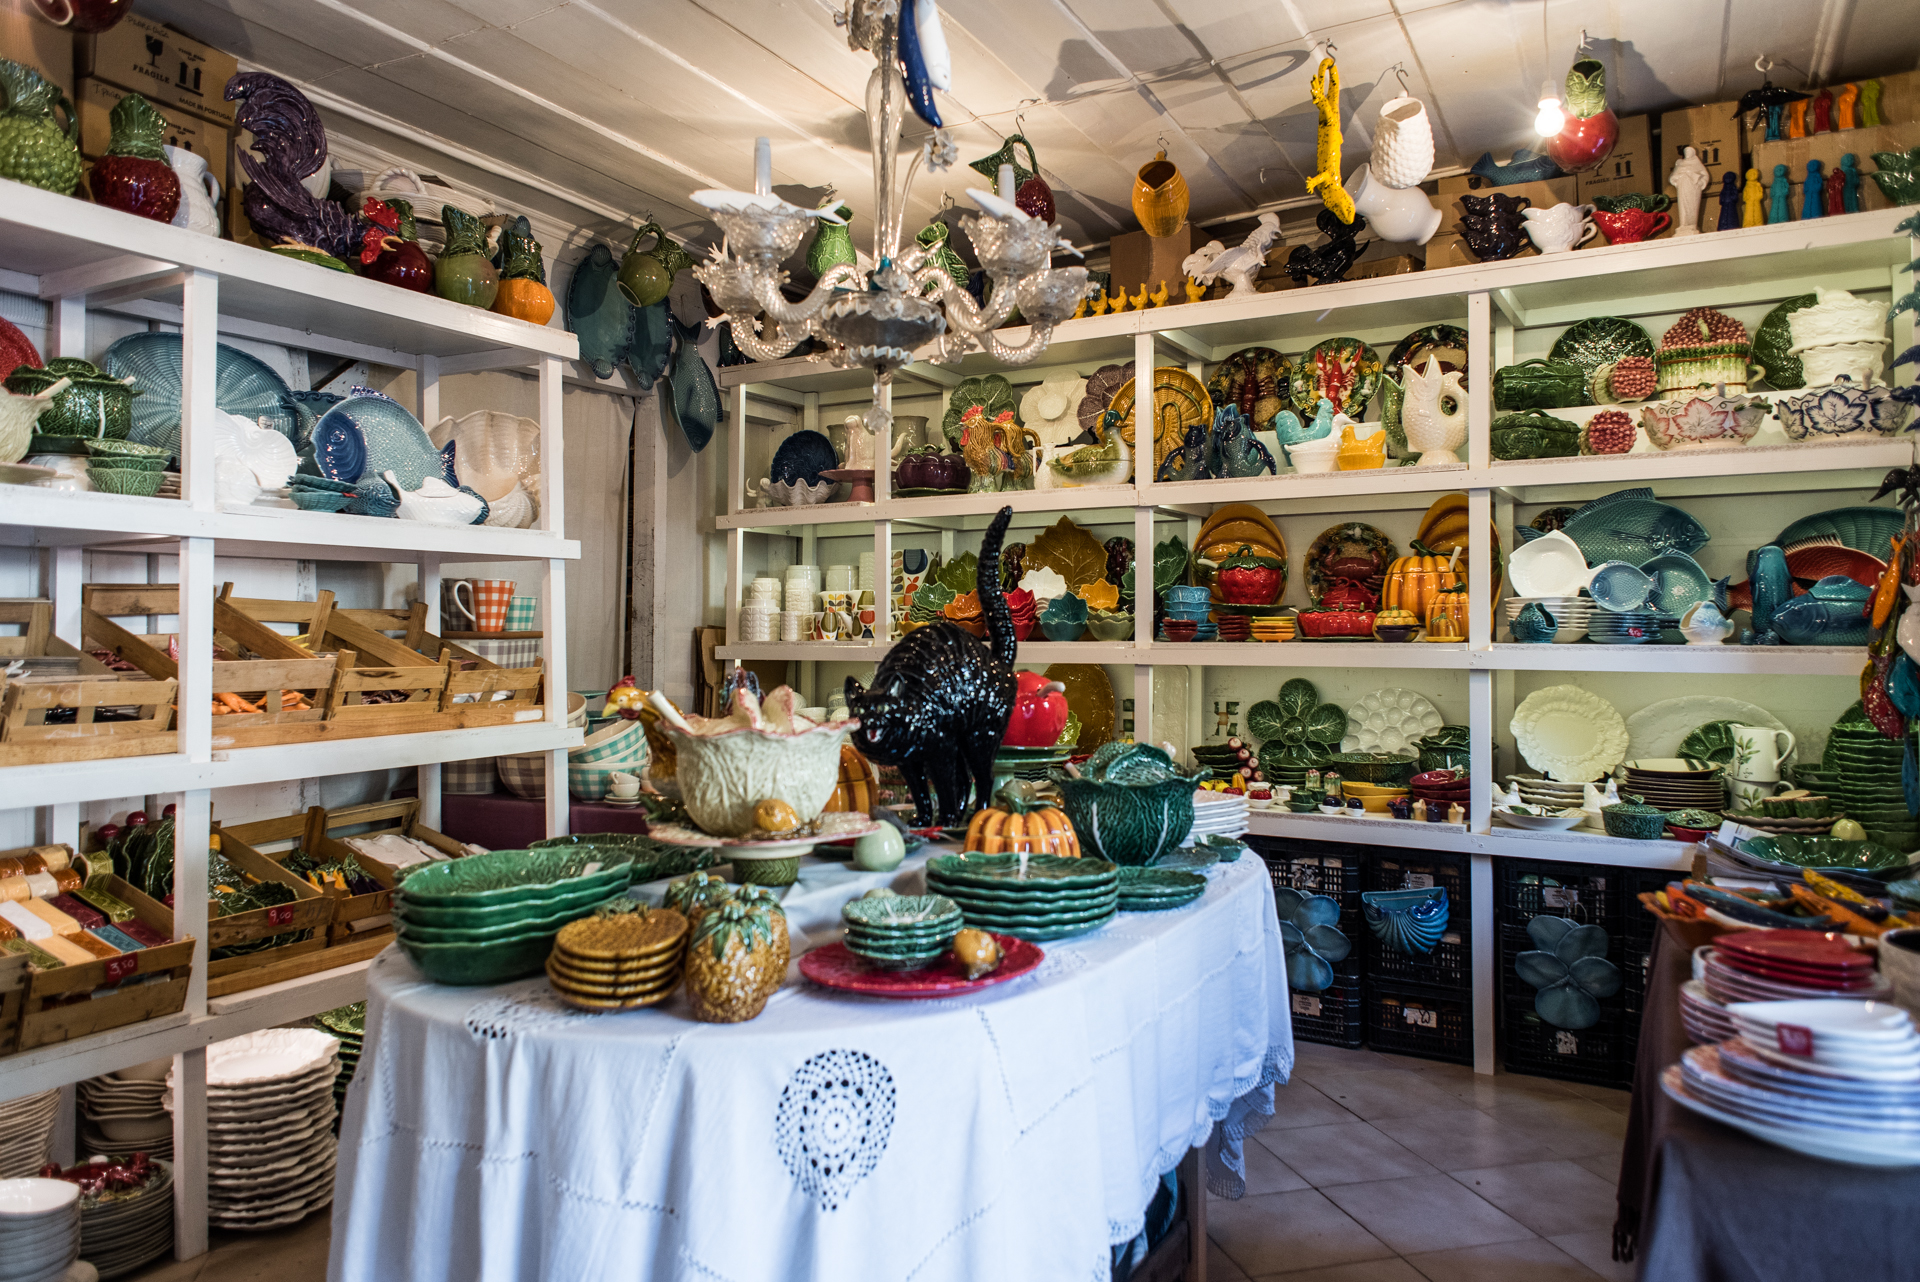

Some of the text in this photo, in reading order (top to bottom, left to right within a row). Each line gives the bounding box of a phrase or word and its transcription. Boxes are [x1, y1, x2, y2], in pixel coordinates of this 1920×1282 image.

[132, 64, 170, 84] FRAGILE
[179, 97, 233, 122] MADE IN PORTUGAL
[270, 909, 292, 923] 9,00
[110, 959, 136, 976] 3,50
